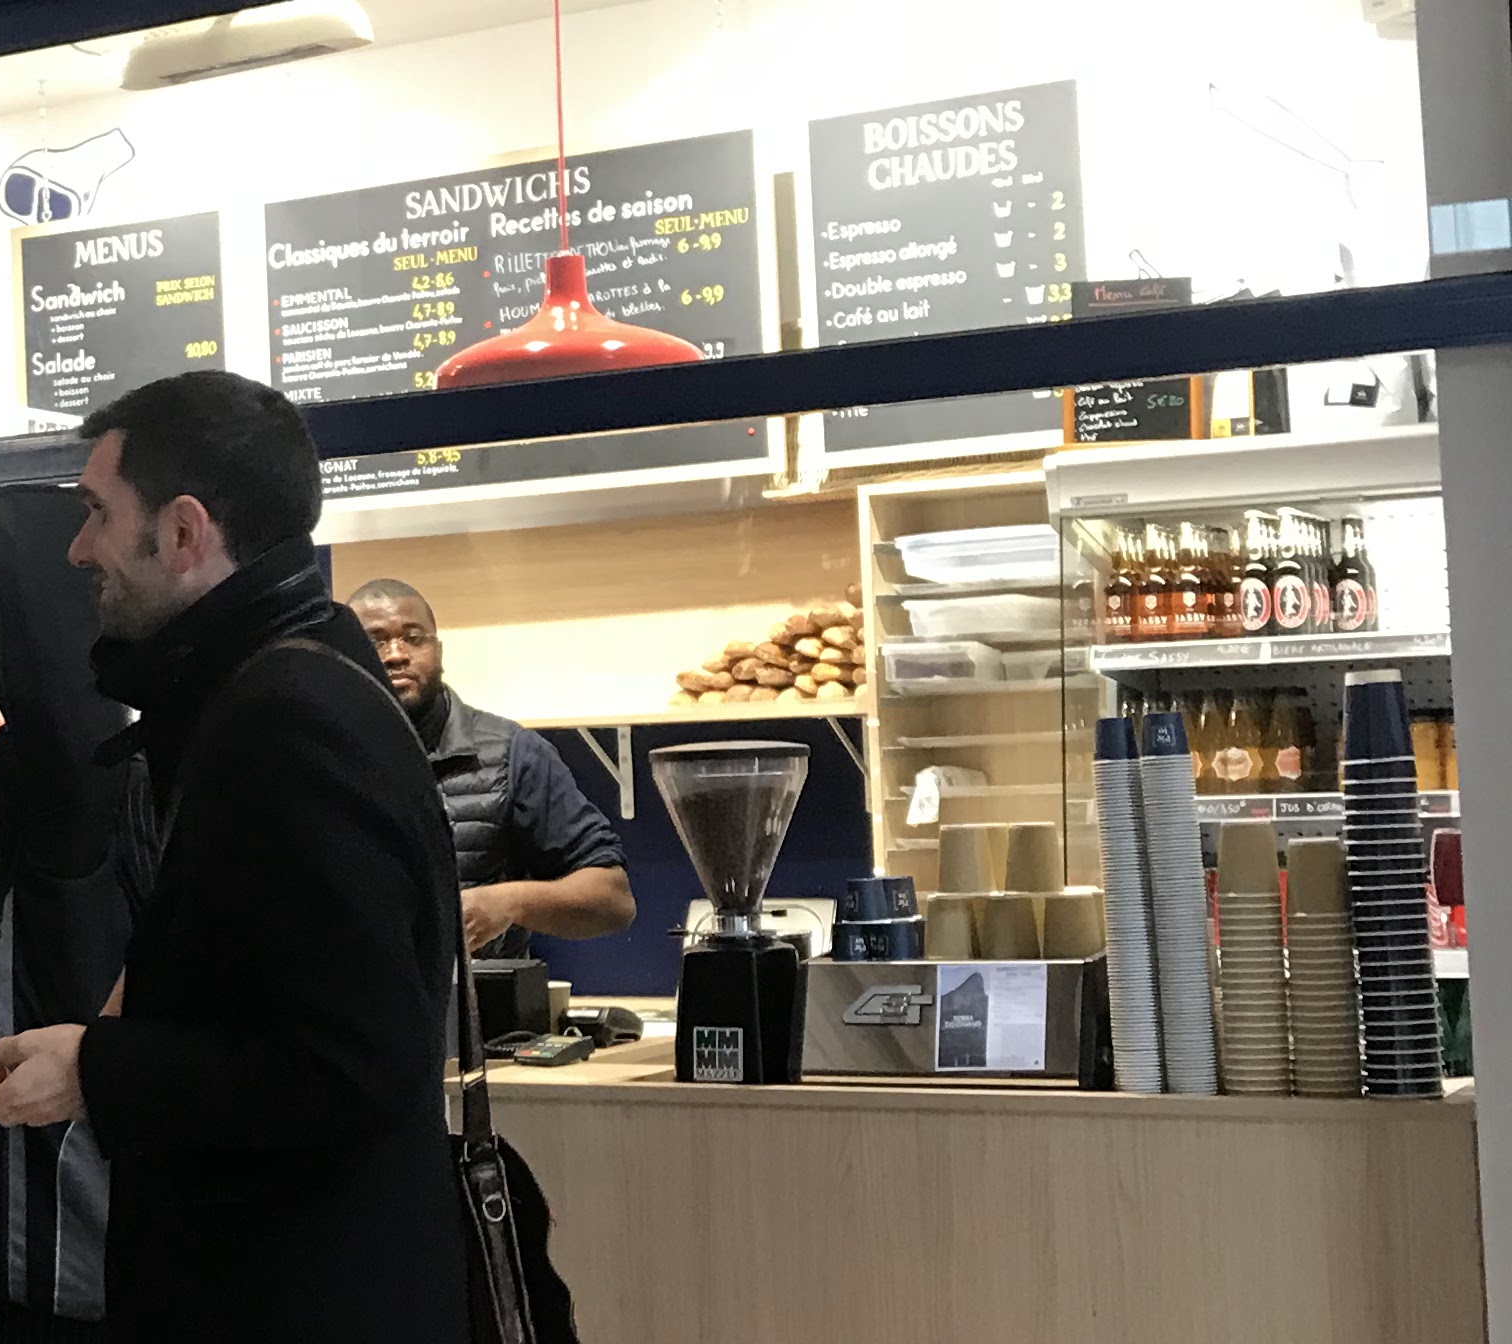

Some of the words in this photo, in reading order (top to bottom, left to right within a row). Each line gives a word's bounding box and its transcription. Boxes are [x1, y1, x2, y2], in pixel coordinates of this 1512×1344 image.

[863, 101, 1025, 154] BOISSONS
[867, 140, 1018, 190] CHAUDES
[405, 166, 591, 219] SANDWICHS
[588, 200, 616, 222] de
[622, 190, 693, 219] saison
[1051, 191, 1066, 210] 2
[828, 218, 901, 241] Espresso
[1053, 222, 1066, 240] 2
[74, 230, 164, 268] MENUS
[268, 240, 369, 269] Classiques
[373, 232, 397, 254] du
[401, 221, 469, 250] terroir
[829, 249, 896, 271] Espresso
[899, 235, 958, 261] allongé
[1054, 253, 1067, 272] 3
[31, 281, 125, 312] Sandwich
[281, 288, 352, 308] EMMENTAL
[588, 285, 638, 302] AROTTES
[832, 276, 892, 299] Double
[896, 271, 967, 292] espresso
[282, 317, 348, 337] SAUCISSON
[833, 307, 873, 328] Café
[877, 309, 898, 323] au
[903, 300, 930, 320] lait
[32, 349, 96, 375] Salade
[282, 348, 331, 364] PARISIEN
[285, 387, 322, 401] MIXTE
